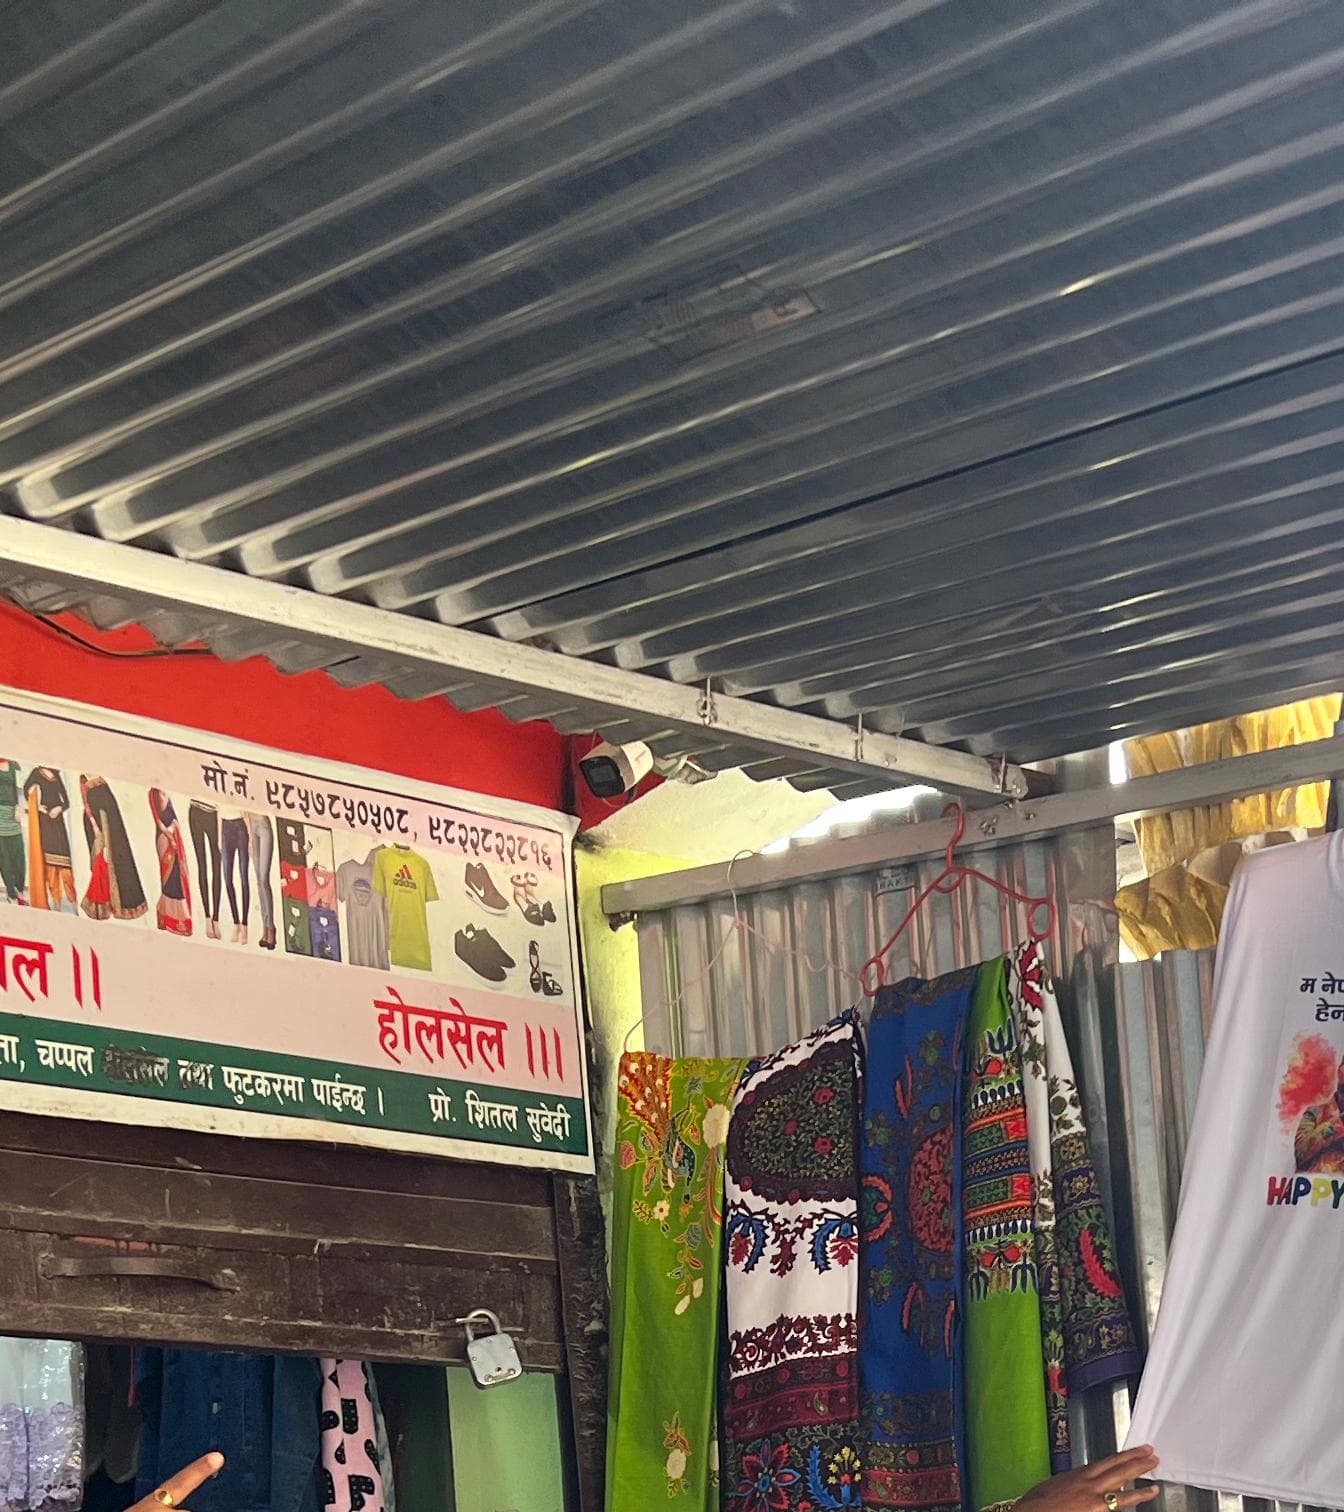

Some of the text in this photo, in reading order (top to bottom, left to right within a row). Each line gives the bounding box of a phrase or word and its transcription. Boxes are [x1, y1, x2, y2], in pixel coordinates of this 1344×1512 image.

[373, 986, 508, 1072] होलसेल
[36, 1038, 94, 1077] चप्पल
[221, 1066, 305, 1105] फुटकरमा
[429, 1088, 571, 1142] प्रो. शितल सुवेदी
